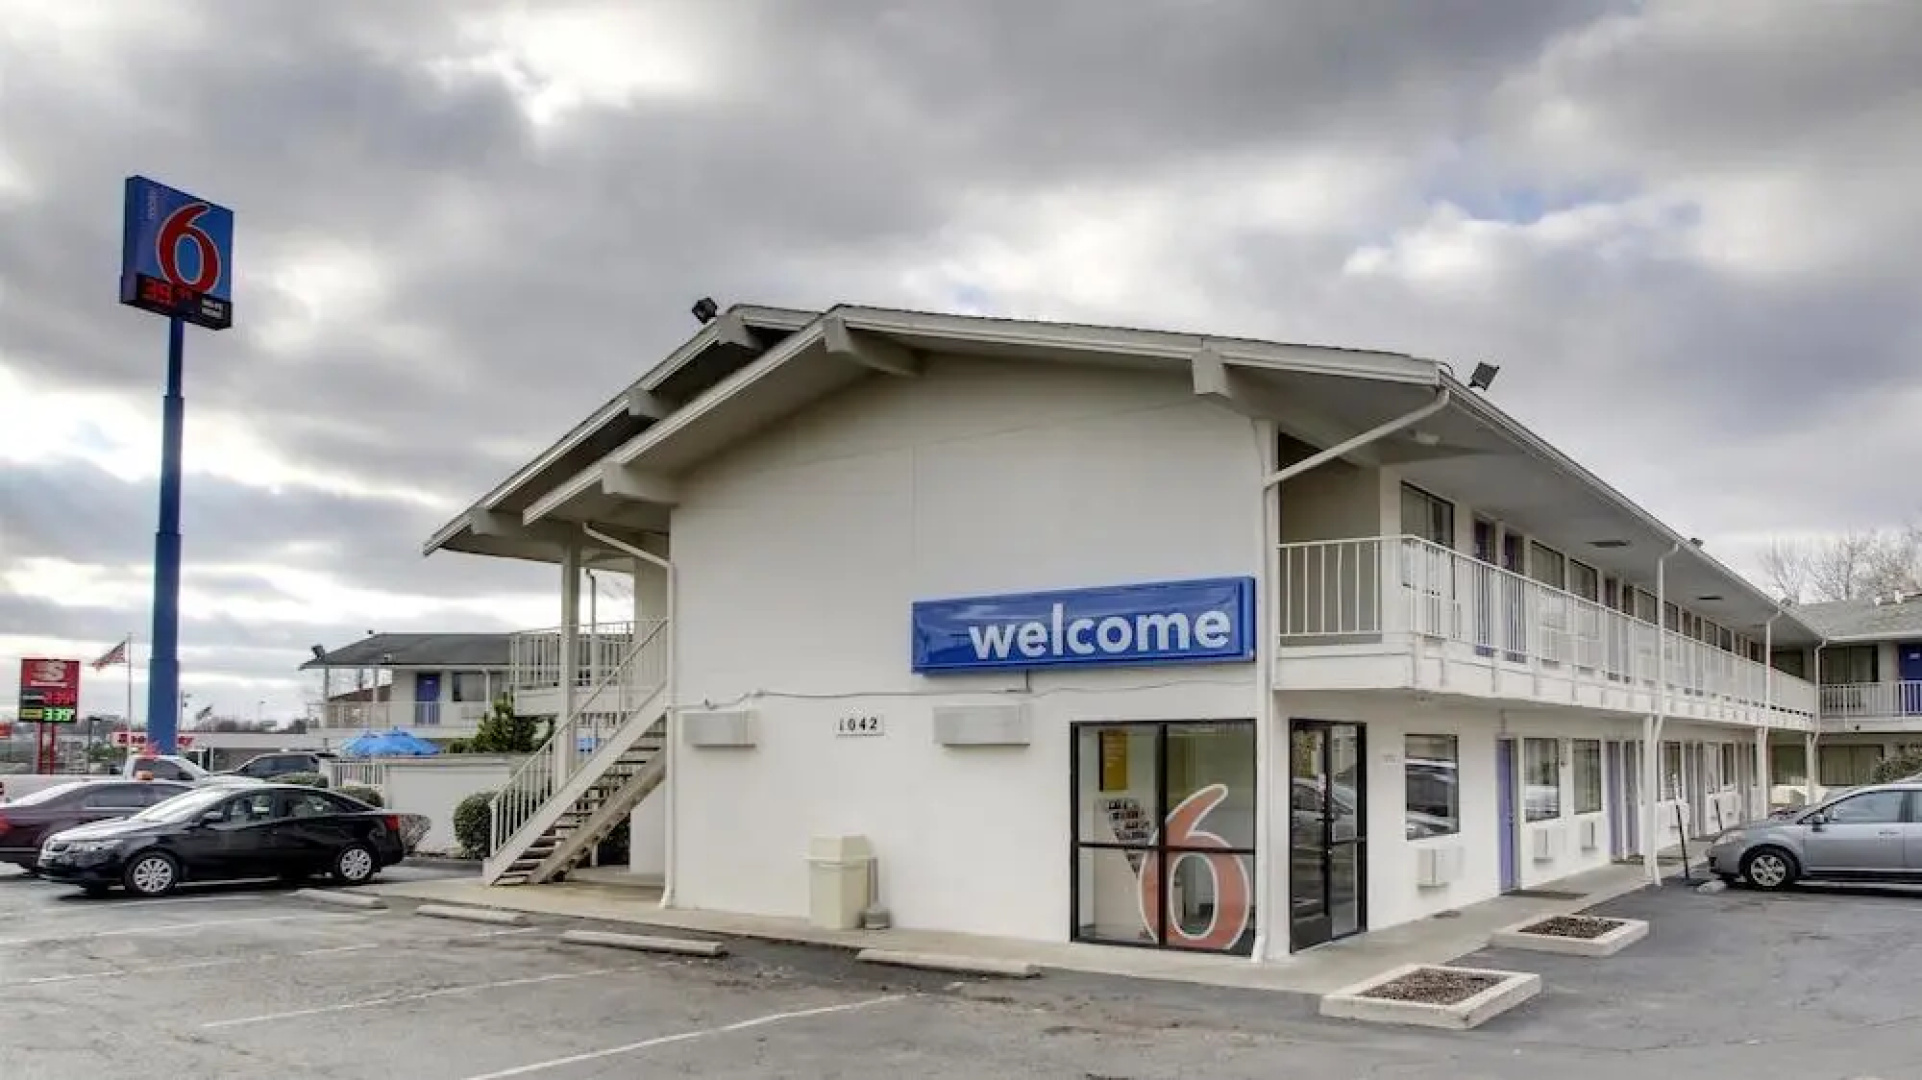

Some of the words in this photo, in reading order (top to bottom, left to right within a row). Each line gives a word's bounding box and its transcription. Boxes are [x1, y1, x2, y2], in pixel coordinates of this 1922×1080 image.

[155, 201, 221, 294] 6
[968, 602, 1231, 660] welcome
[839, 716, 877, 732] 1042
[1138, 783, 1251, 950] 6
